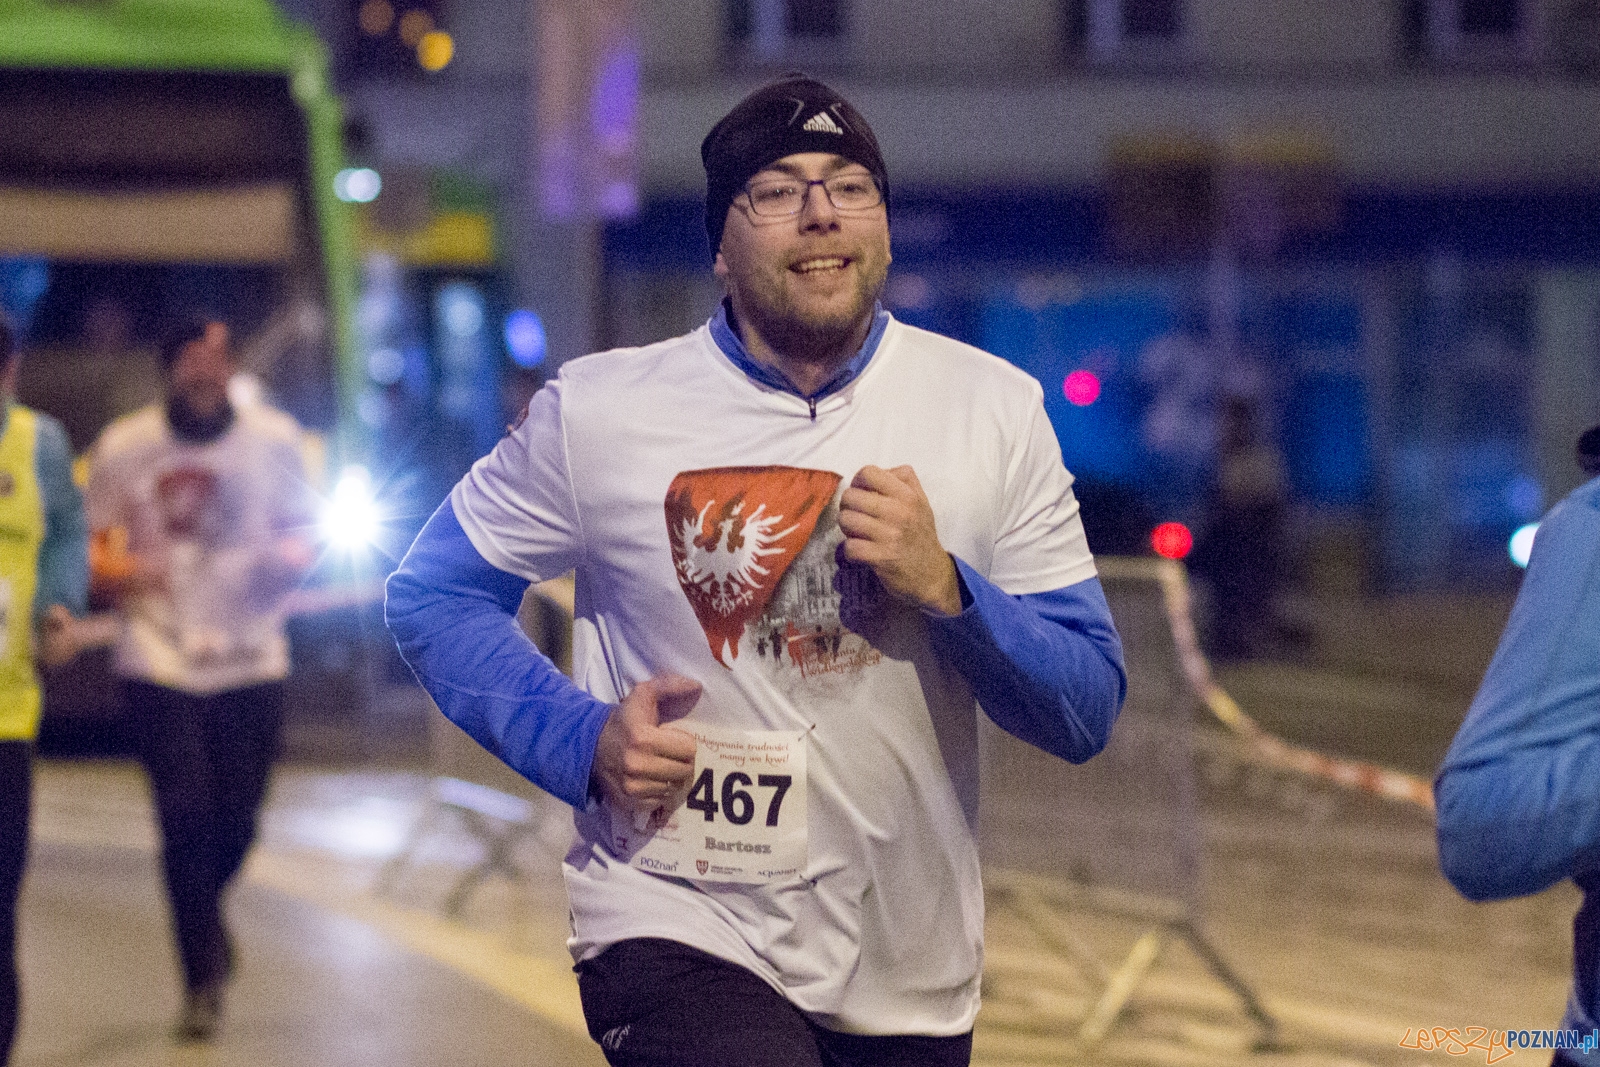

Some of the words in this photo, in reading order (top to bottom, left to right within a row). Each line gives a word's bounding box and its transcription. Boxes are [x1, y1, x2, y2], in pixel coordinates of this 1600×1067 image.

[803, 122, 843, 135] adidas
[719, 753, 746, 767] mamy
[765, 752, 790, 767] krwi!
[686, 767, 792, 827] 467
[704, 837, 772, 854] Bartosz
